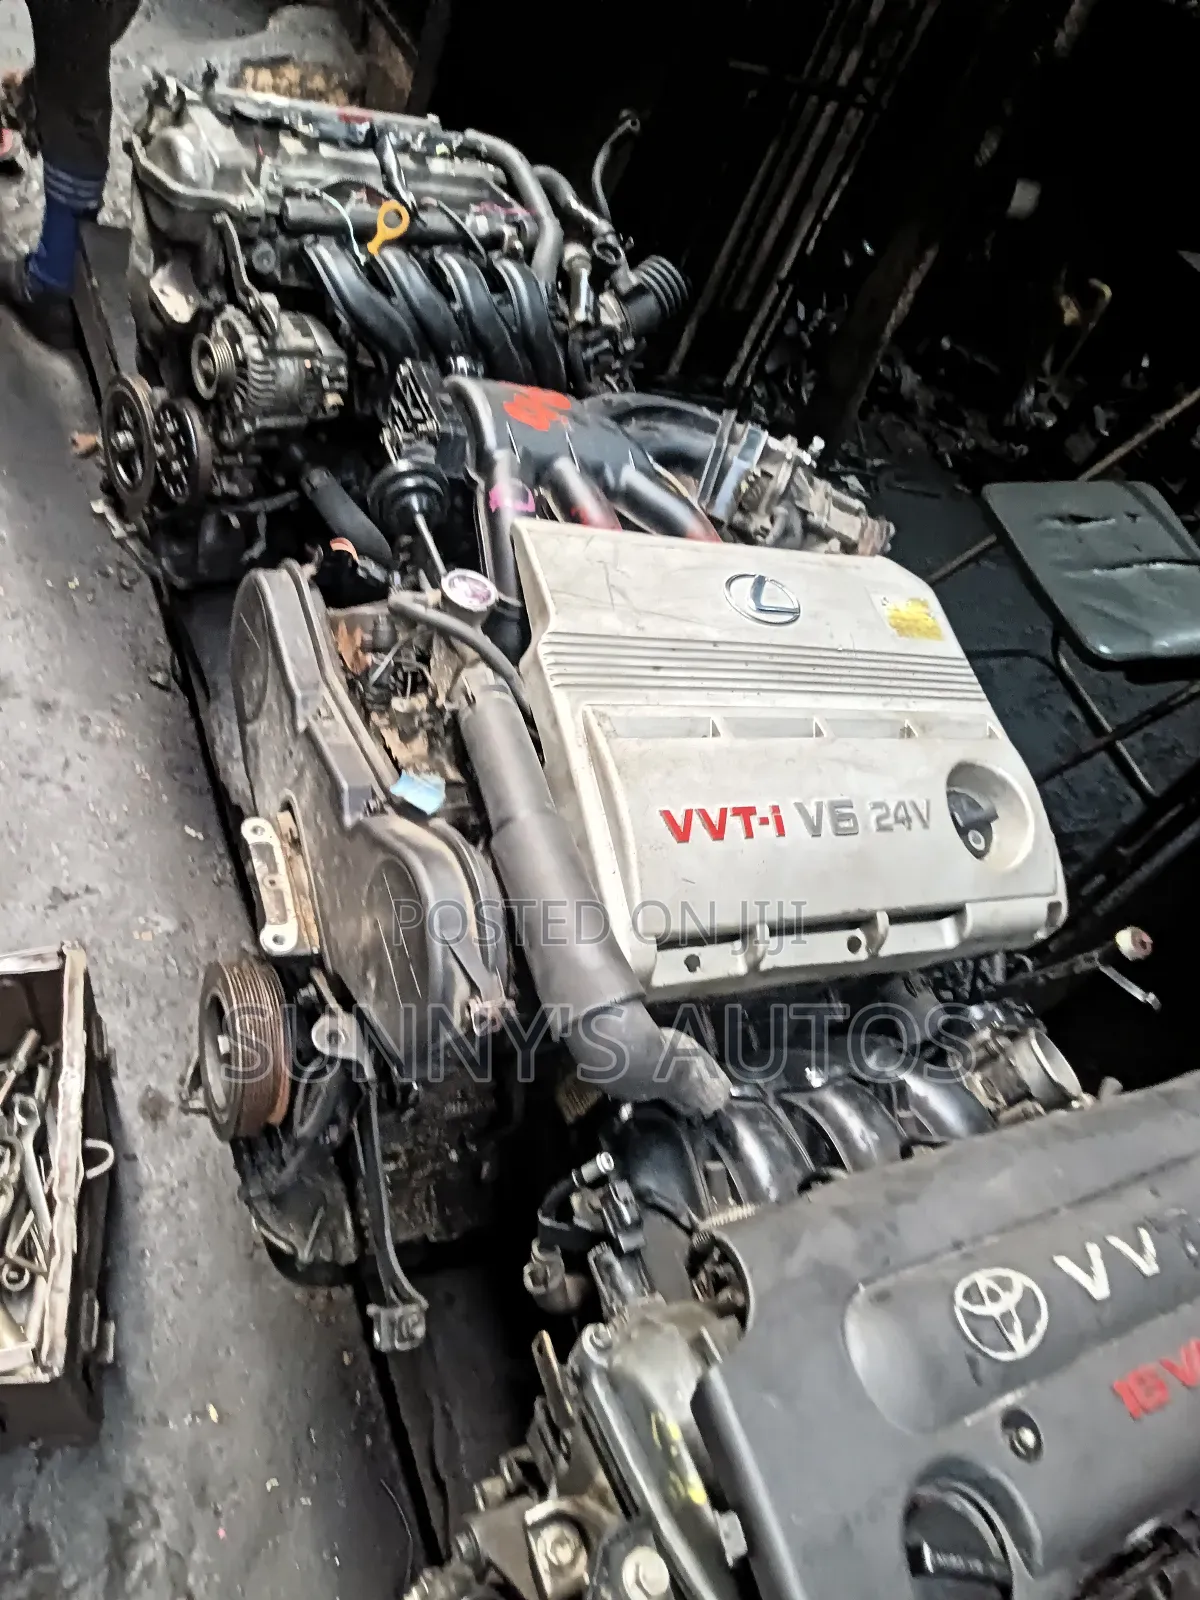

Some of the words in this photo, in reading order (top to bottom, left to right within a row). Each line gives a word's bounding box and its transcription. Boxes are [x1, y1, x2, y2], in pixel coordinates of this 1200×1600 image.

[659, 804, 786, 844] VVT-i
[793, 800, 859, 837] V6
[869, 799, 931, 832] 24V
